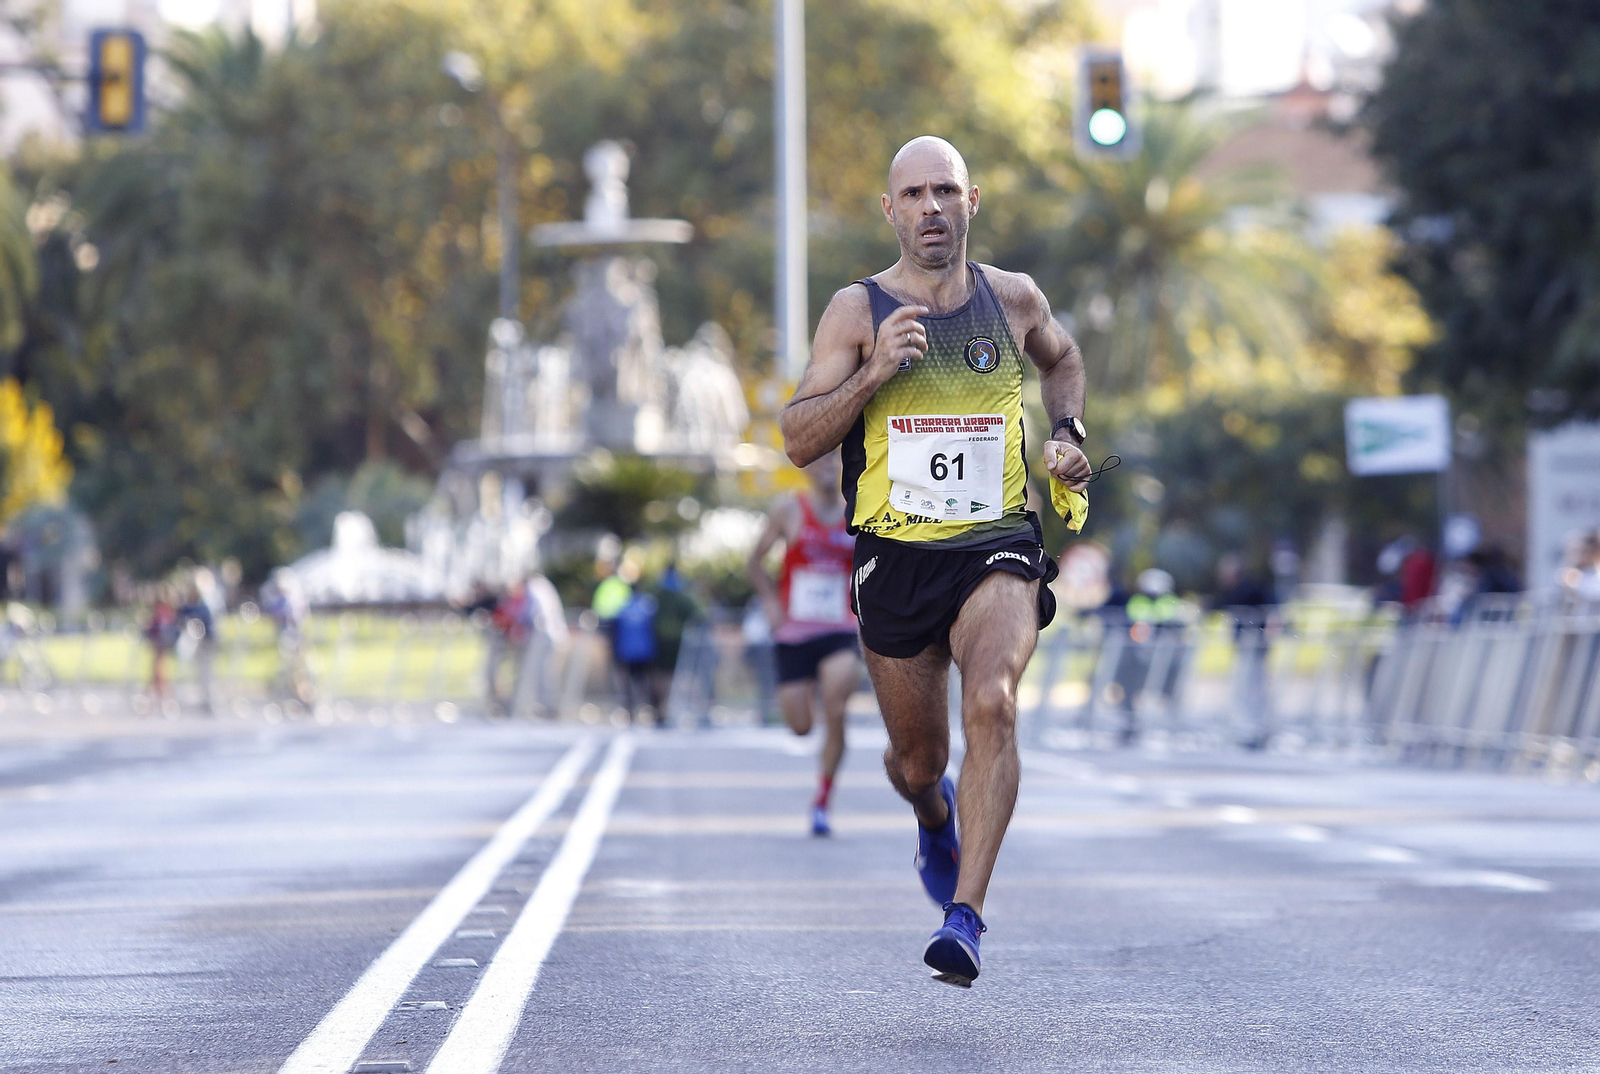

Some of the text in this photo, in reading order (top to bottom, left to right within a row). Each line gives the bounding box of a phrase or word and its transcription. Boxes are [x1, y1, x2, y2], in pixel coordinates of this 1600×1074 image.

[891, 417, 1004, 433] 41 CARRERA URBANA
[930, 452, 964, 481] 61
